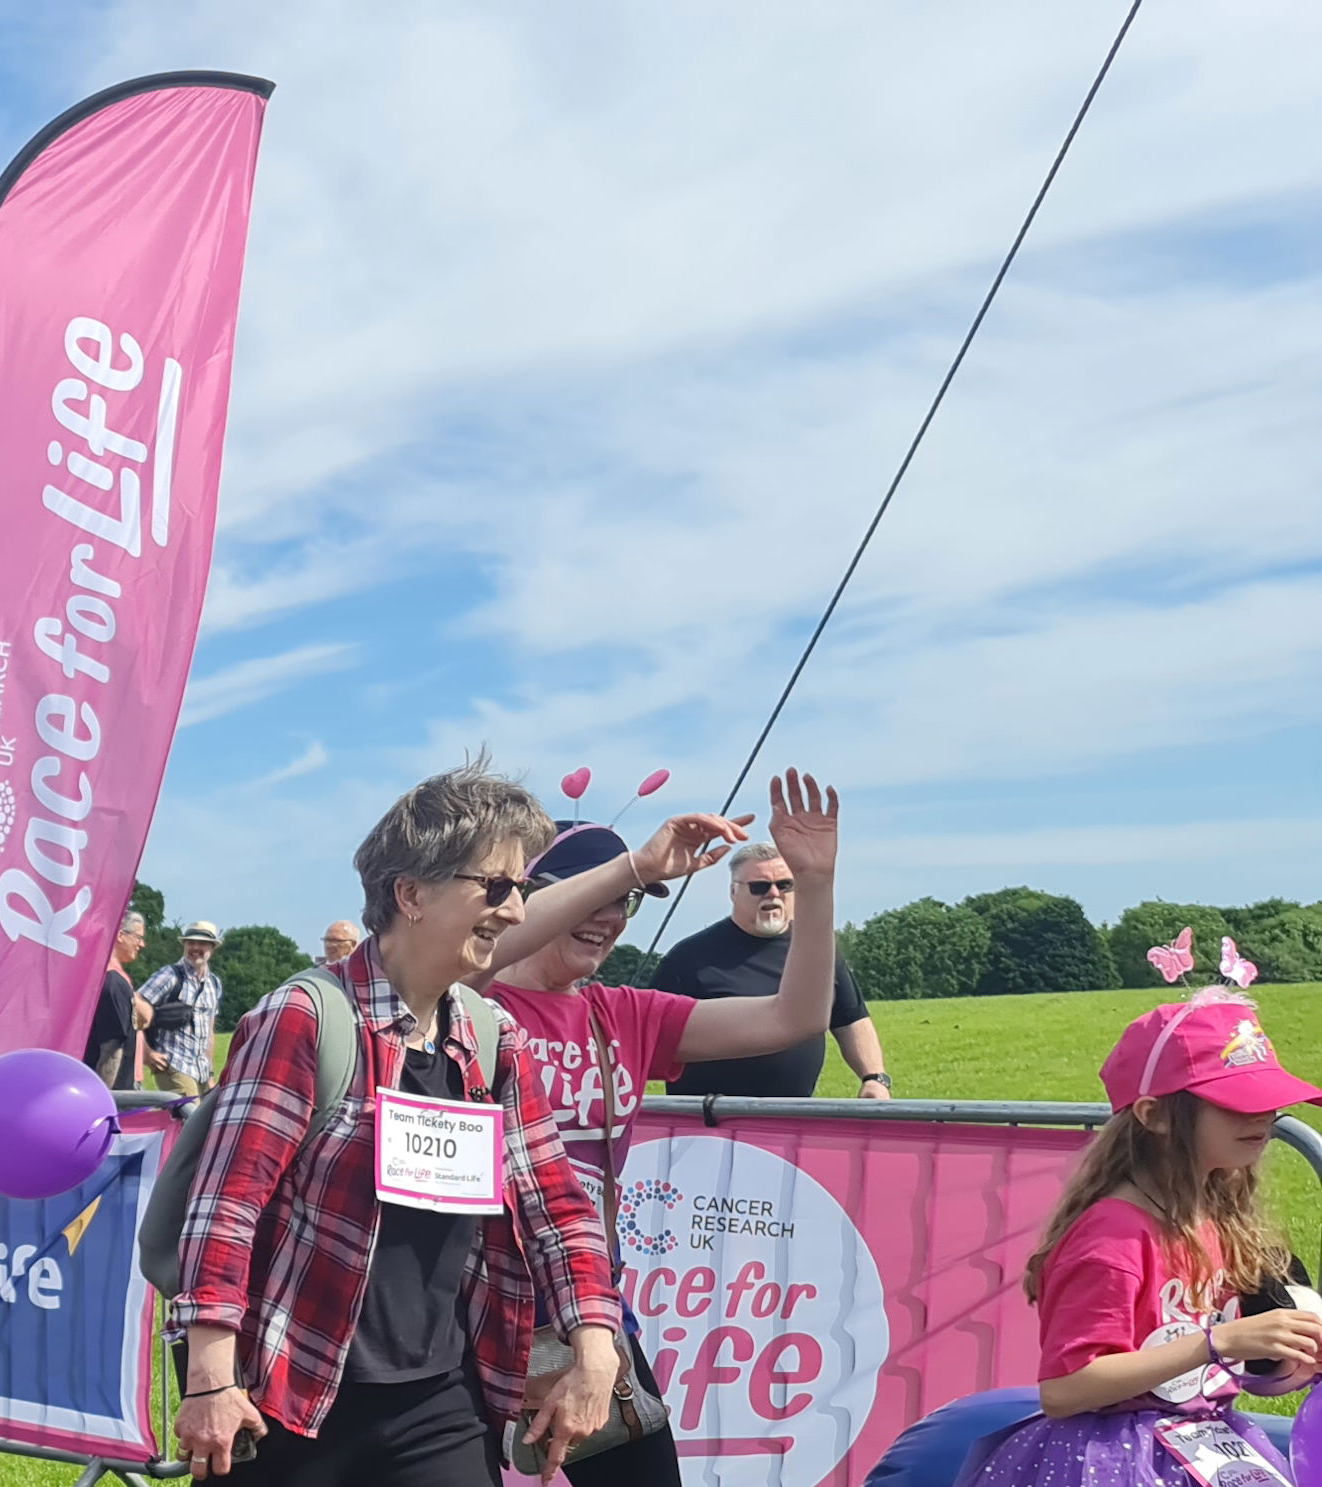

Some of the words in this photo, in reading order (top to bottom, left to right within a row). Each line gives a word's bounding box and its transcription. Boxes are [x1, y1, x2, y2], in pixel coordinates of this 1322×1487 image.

[42, 316, 148, 558] Life
[34, 543, 122, 684] for
[389, 1109, 415, 1124] Team
[459, 1121, 484, 1133] Boo
[405, 1131, 458, 1160] 10210
[435, 1171, 466, 1182] Standard
[693, 1195, 774, 1218] CANCER
[691, 1215, 795, 1240] RESEARCH
[690, 1234, 715, 1252] UK
[725, 1260, 818, 1320] for
[636, 1325, 823, 1432] ife
